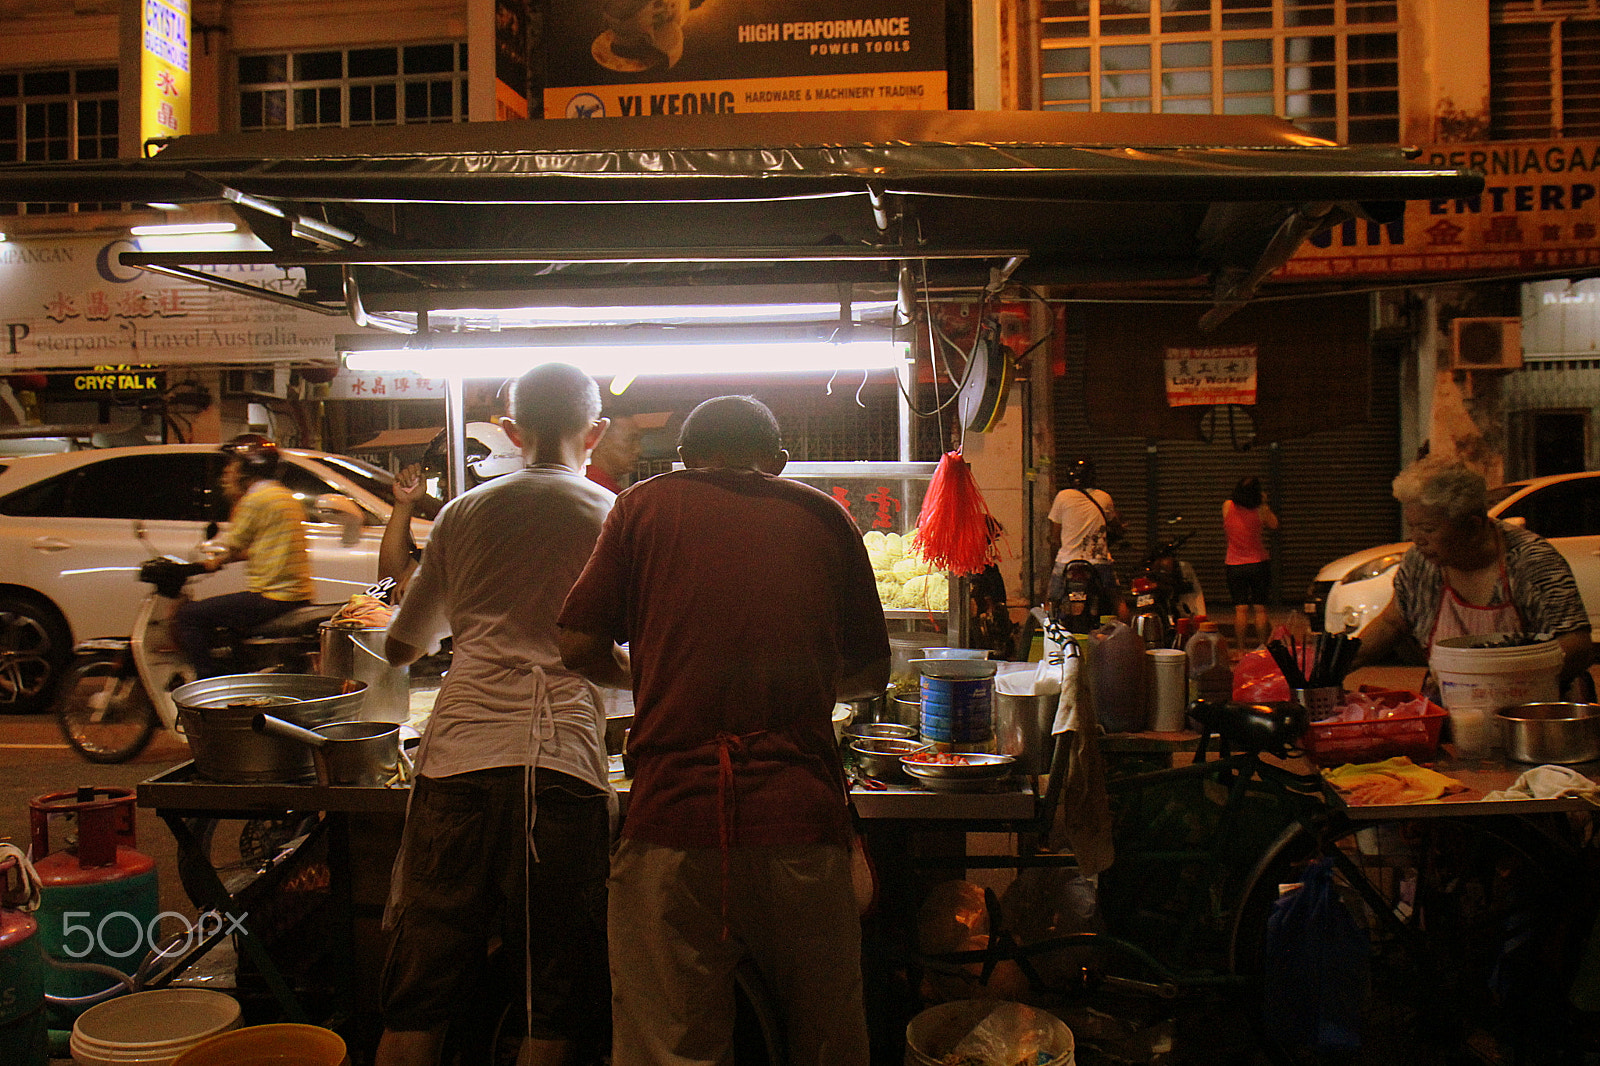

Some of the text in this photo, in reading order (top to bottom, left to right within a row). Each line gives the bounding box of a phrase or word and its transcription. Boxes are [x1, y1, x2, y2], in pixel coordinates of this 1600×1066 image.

[146, 0, 188, 48] CRYSTAL
[738, 17, 910, 43] HIGH PERFORMANCE
[810, 40, 911, 55] POWER TOOLS
[156, 72, 179, 137] 水晶
[745, 85, 924, 102] HARDWARE & MACHINERY TRADING
[6, 323, 117, 356] Peterpans
[142, 328, 200, 348] Travel
[211, 327, 297, 347] Australia
[352, 377, 446, 395] 水晶傳統
